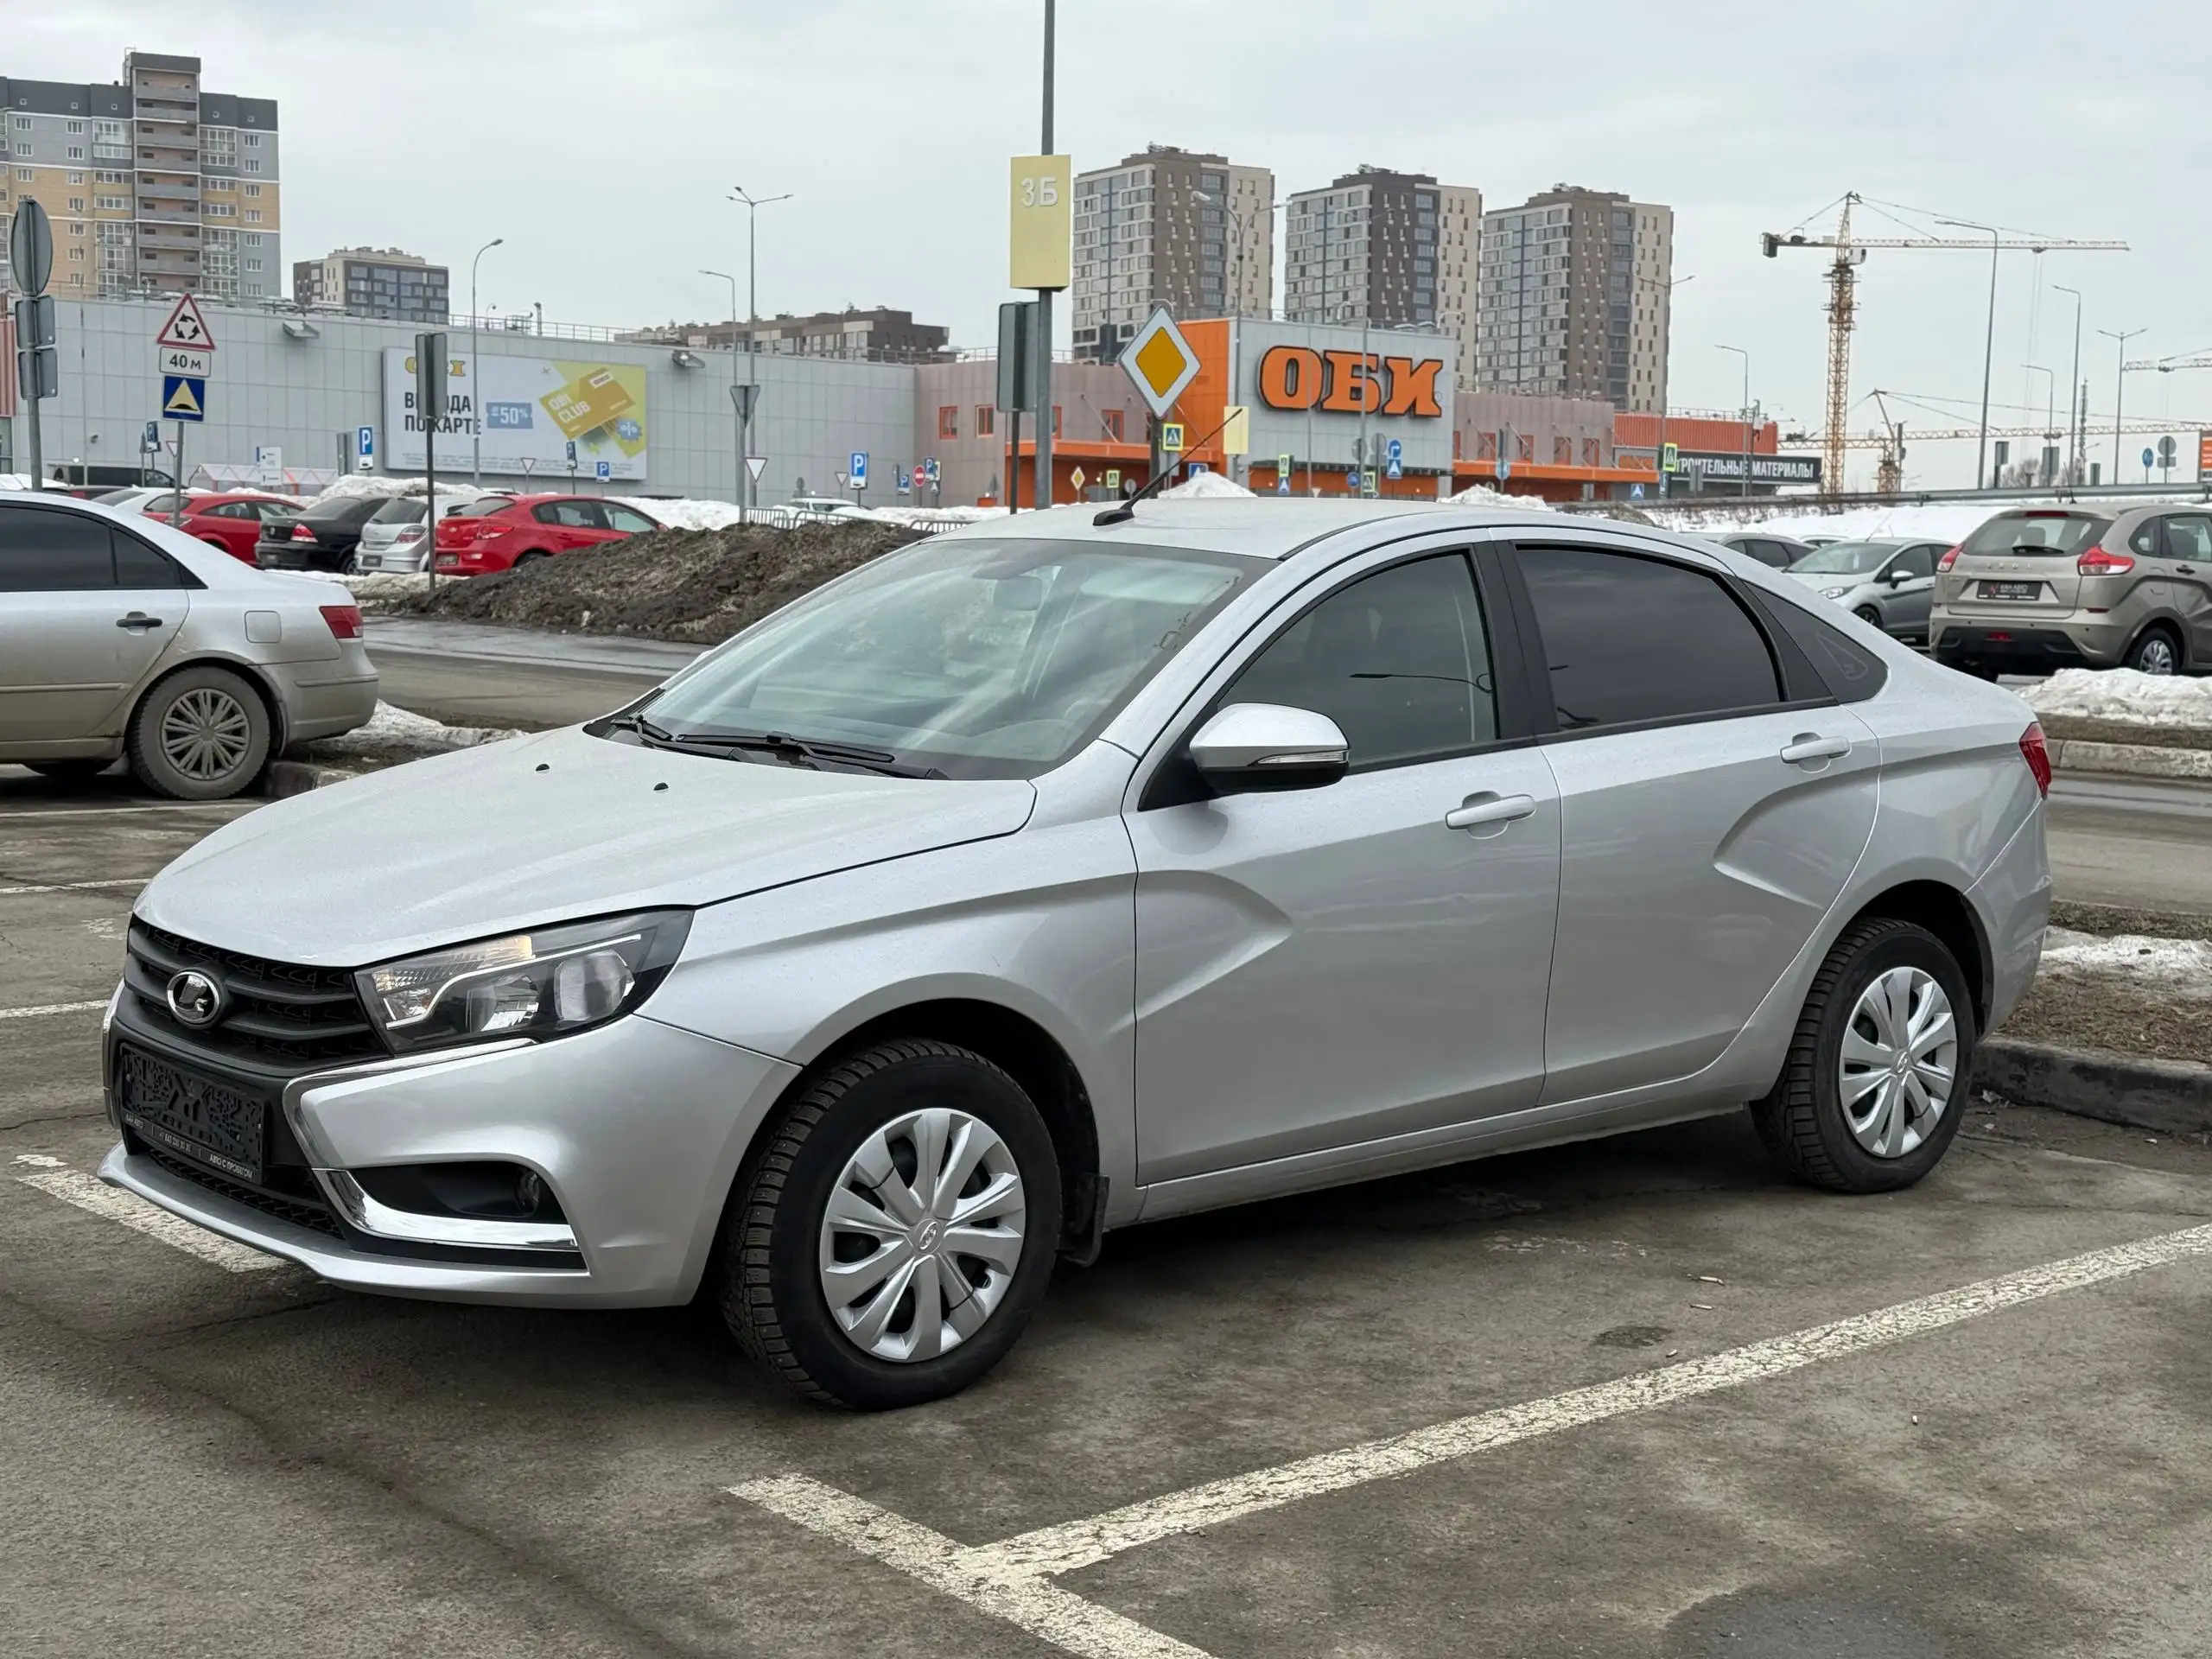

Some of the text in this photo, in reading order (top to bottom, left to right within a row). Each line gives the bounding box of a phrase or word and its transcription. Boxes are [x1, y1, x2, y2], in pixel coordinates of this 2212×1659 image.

[1020, 176, 1058, 207] 3Б
[168, 353, 188, 368] 40
[1259, 345, 1444, 418] ОБИ
[404, 391, 472, 415] ВДА
[558, 400, 591, 424] CLUB
[361, 429, 371, 454] P
[599, 463, 608, 475] P
[854, 454, 863, 474] P
[1752, 460, 1814, 479] МАТЕРИАЛЫ
[209, 1154, 222, 1166] АВТО
